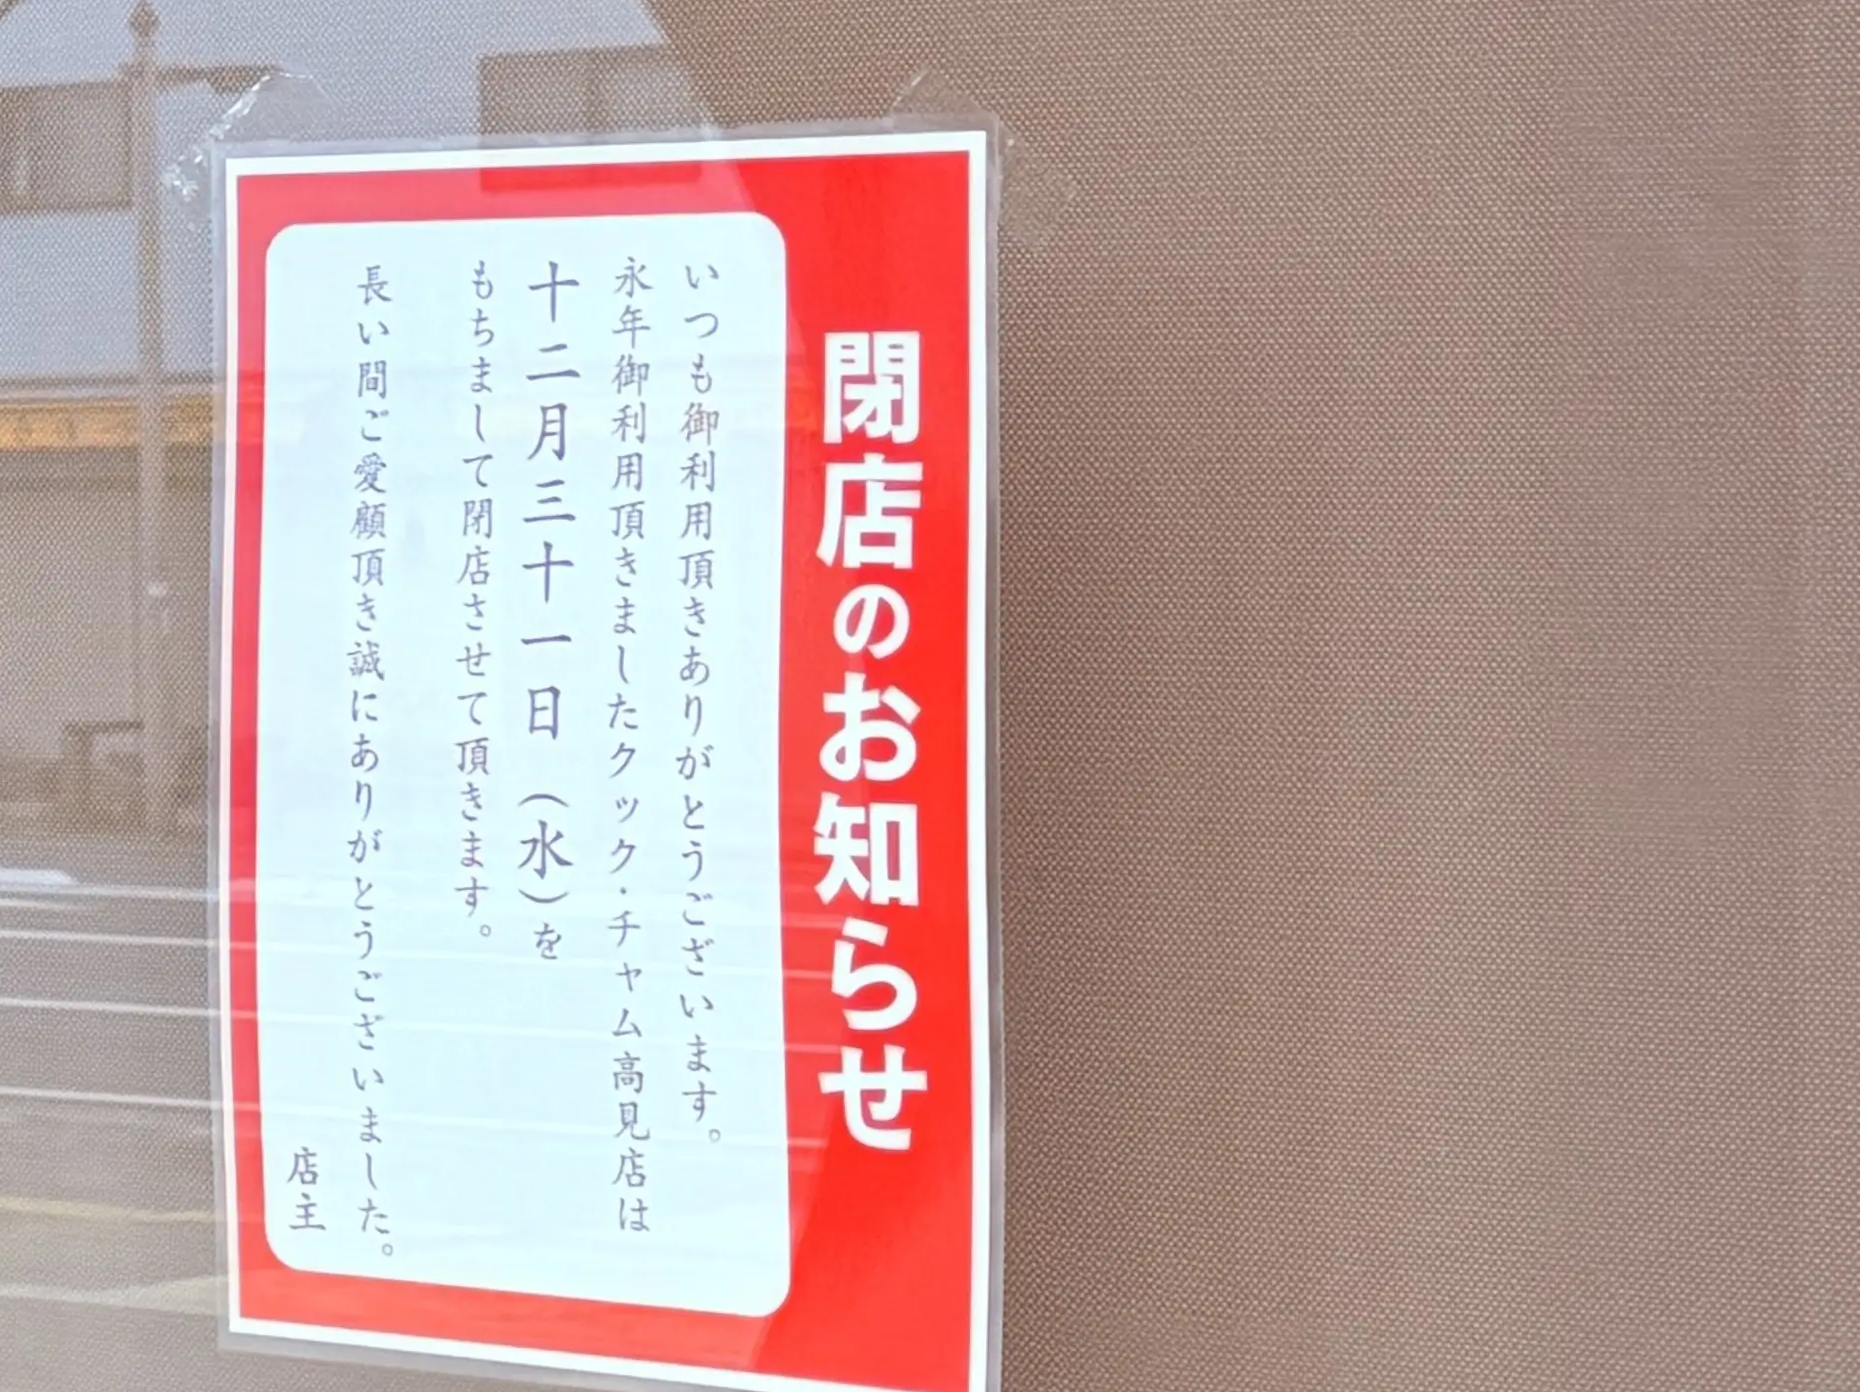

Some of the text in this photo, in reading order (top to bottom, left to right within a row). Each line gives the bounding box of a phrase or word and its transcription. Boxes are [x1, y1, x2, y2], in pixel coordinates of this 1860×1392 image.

[346, 264, 395, 1258] 長い間ご愛顧頂き誠にありがとうございました。
[453, 262, 494, 938] もちまして閉店させて頂きます。
[607, 256, 654, 1234] 永年御利用頂きましたクック・チャム高見店は
[675, 261, 722, 1145] いつも御利用頂きありがとうございます。
[813, 330, 929, 1151] 閉店のお知らせ
[285, 1147, 327, 1234] 店主
